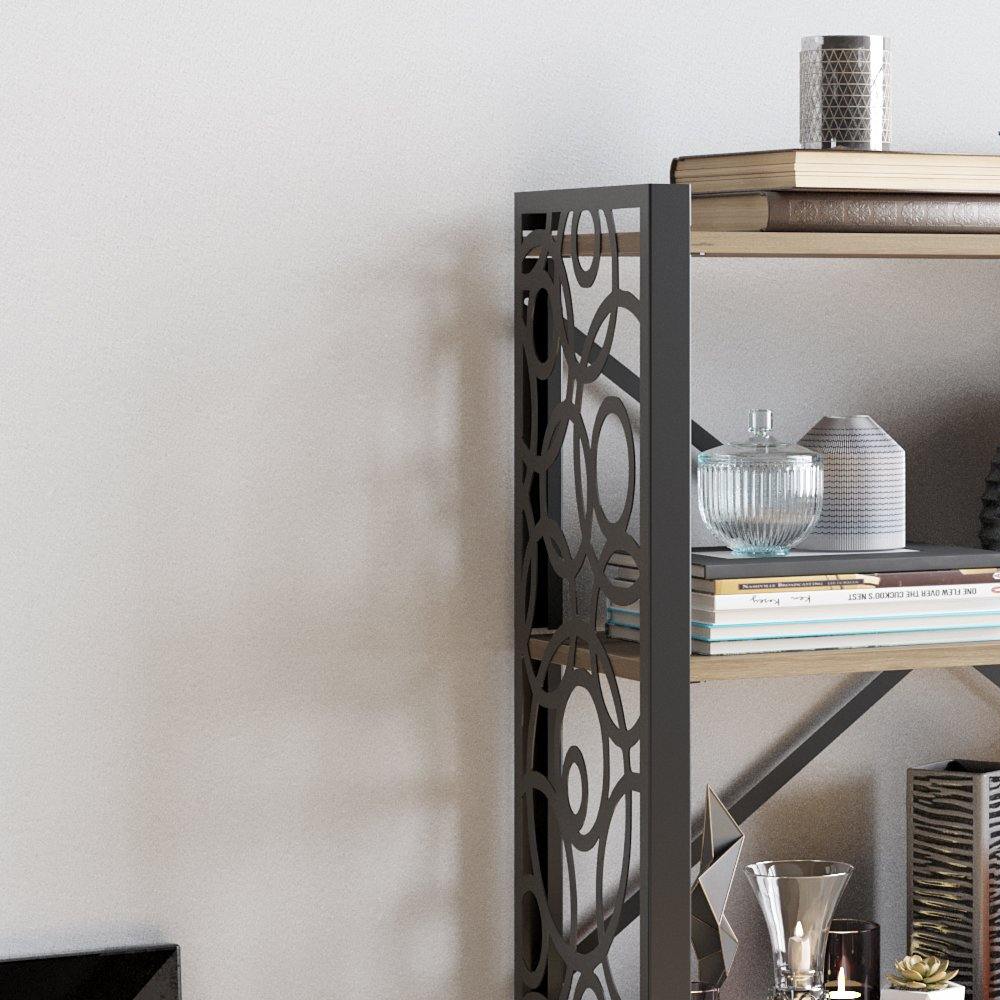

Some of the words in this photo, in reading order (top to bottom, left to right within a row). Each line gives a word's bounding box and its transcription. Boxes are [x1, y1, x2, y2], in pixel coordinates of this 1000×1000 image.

[905, 590, 919, 598] THE
[921, 589, 940, 597] OVER
[942, 588, 961, 596] FLEW
[964, 587, 977, 595] ONE
[868, 591, 904, 600] CUCKOO'S
